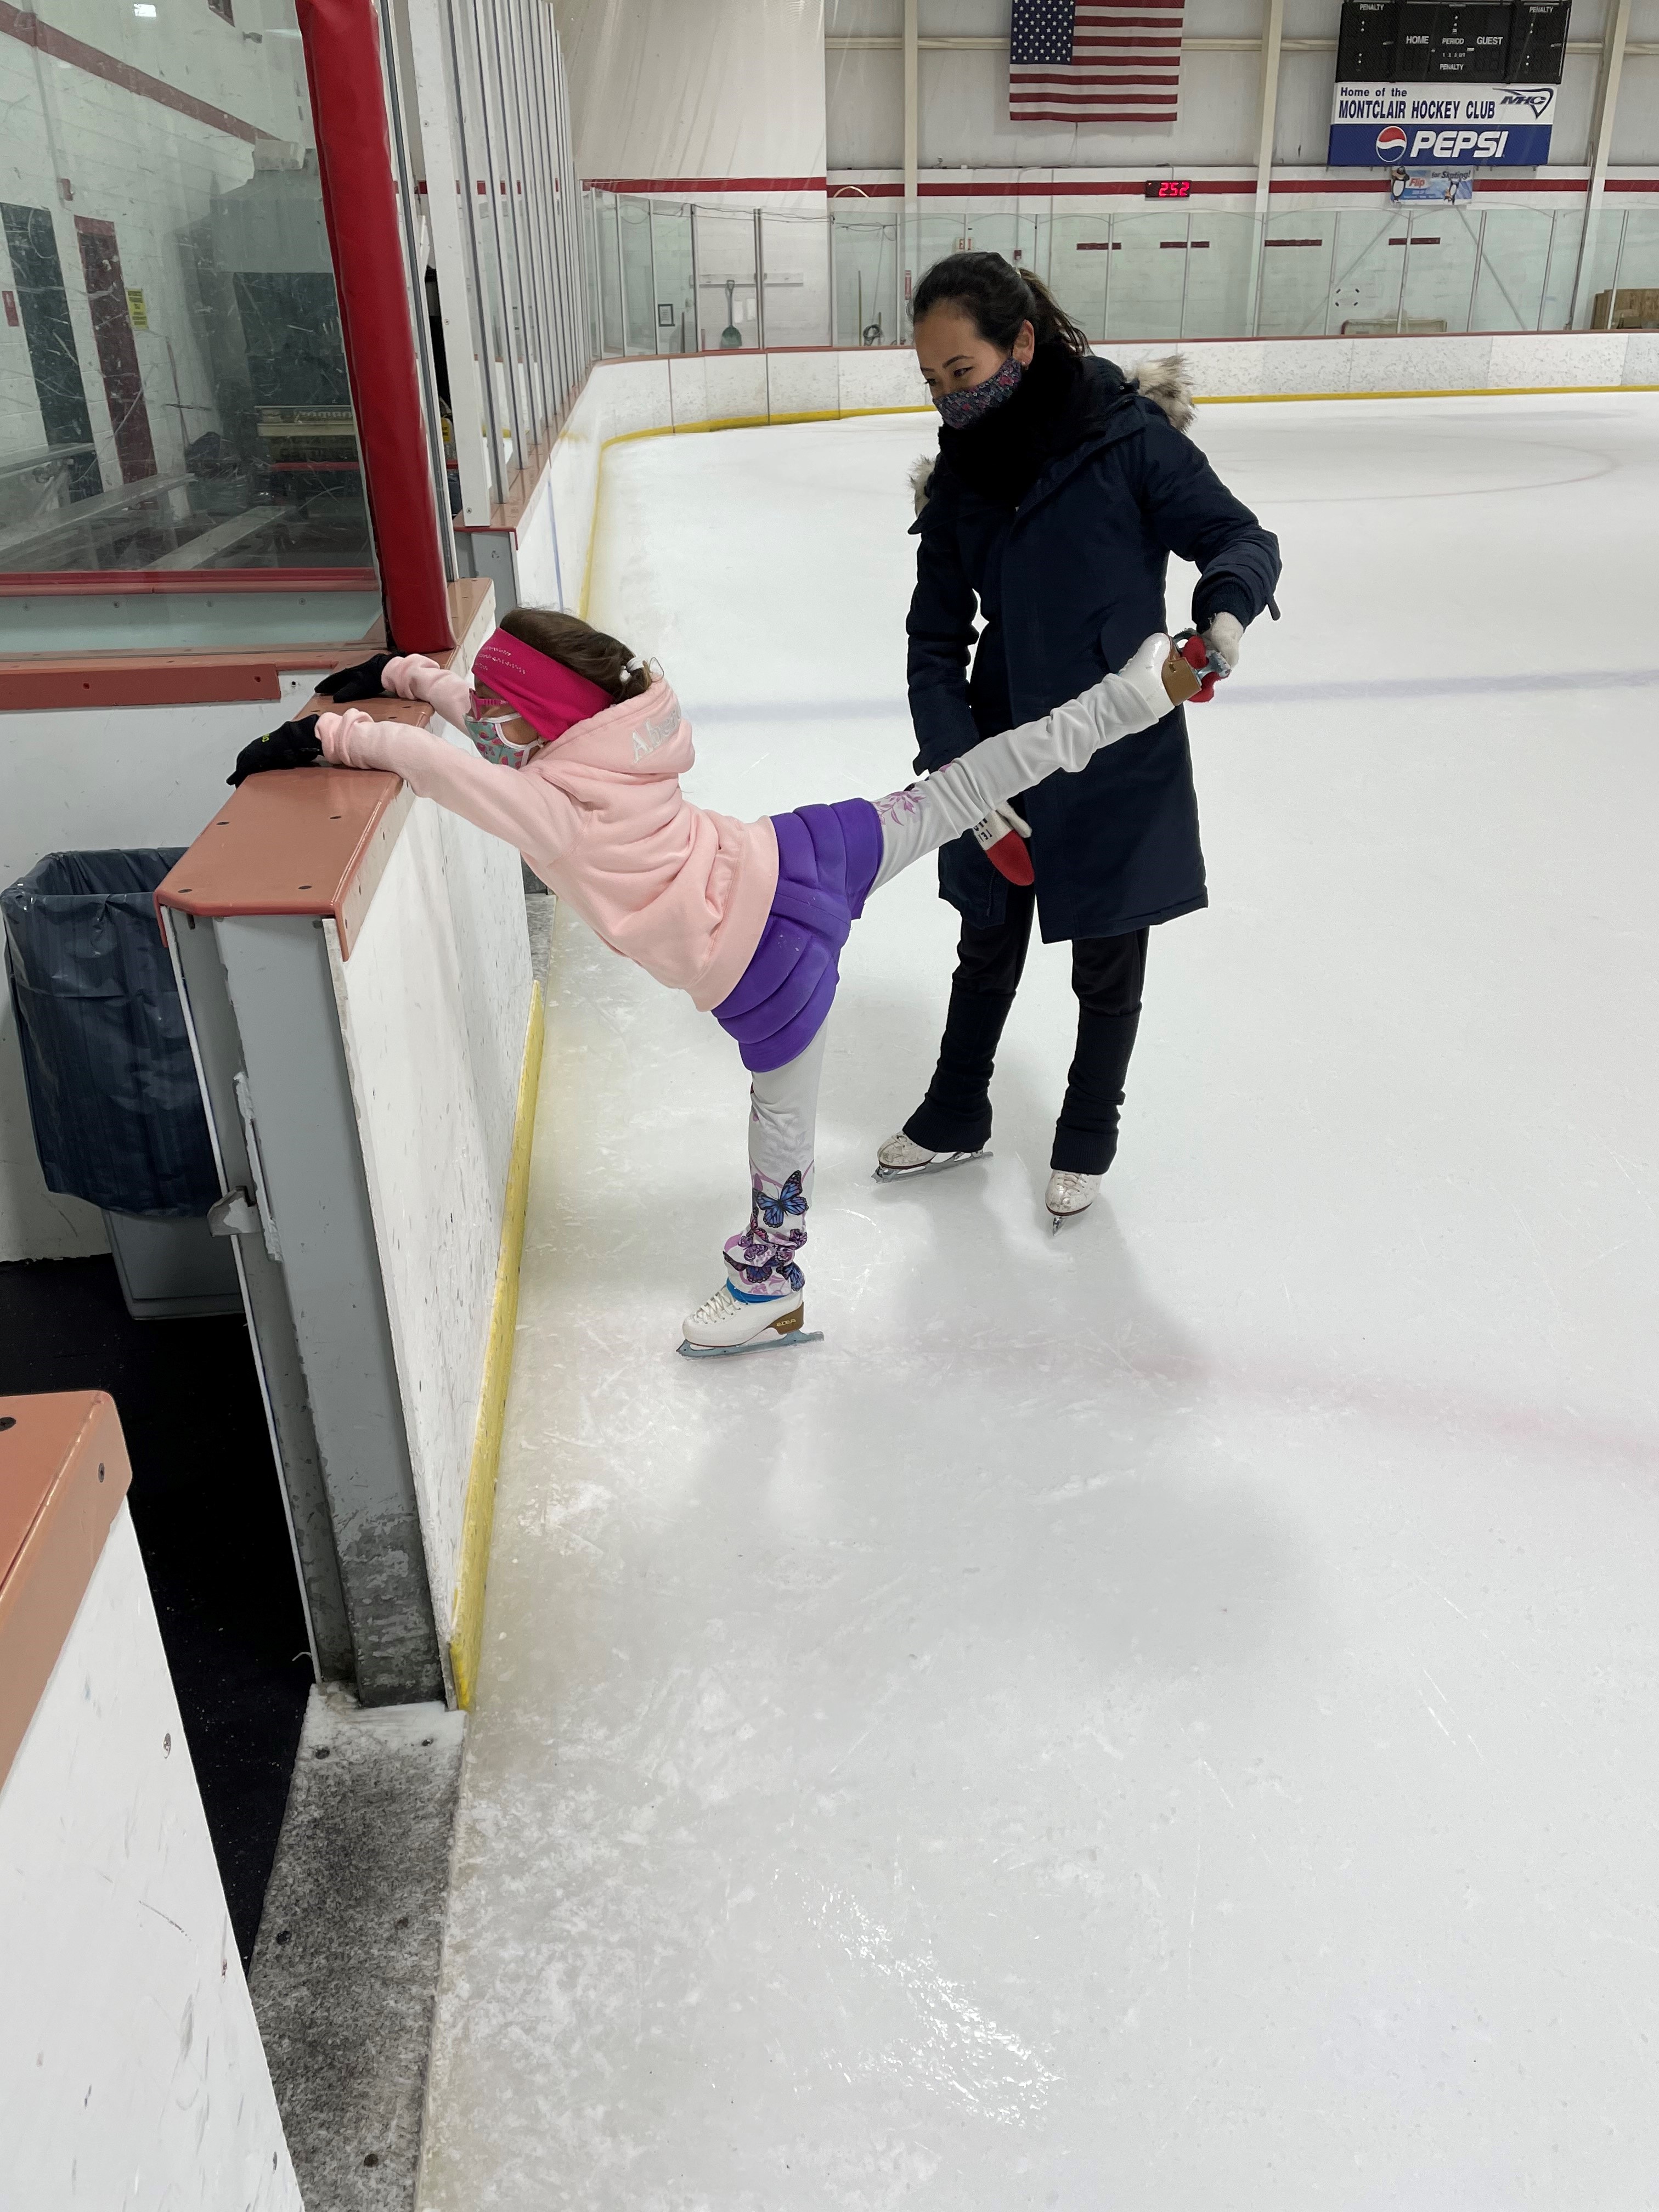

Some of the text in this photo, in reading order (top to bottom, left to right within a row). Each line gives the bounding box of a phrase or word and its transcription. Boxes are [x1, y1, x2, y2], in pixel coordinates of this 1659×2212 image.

[1406, 36, 1429, 44] HOME
[1476, 36, 1503, 45] GUEST
[1340, 87, 1407, 97] Home of the
[1339, 100, 1495, 119] MONTCLAIR HOCKEY CLUB
[1410, 131, 1509, 158] PEPSI
